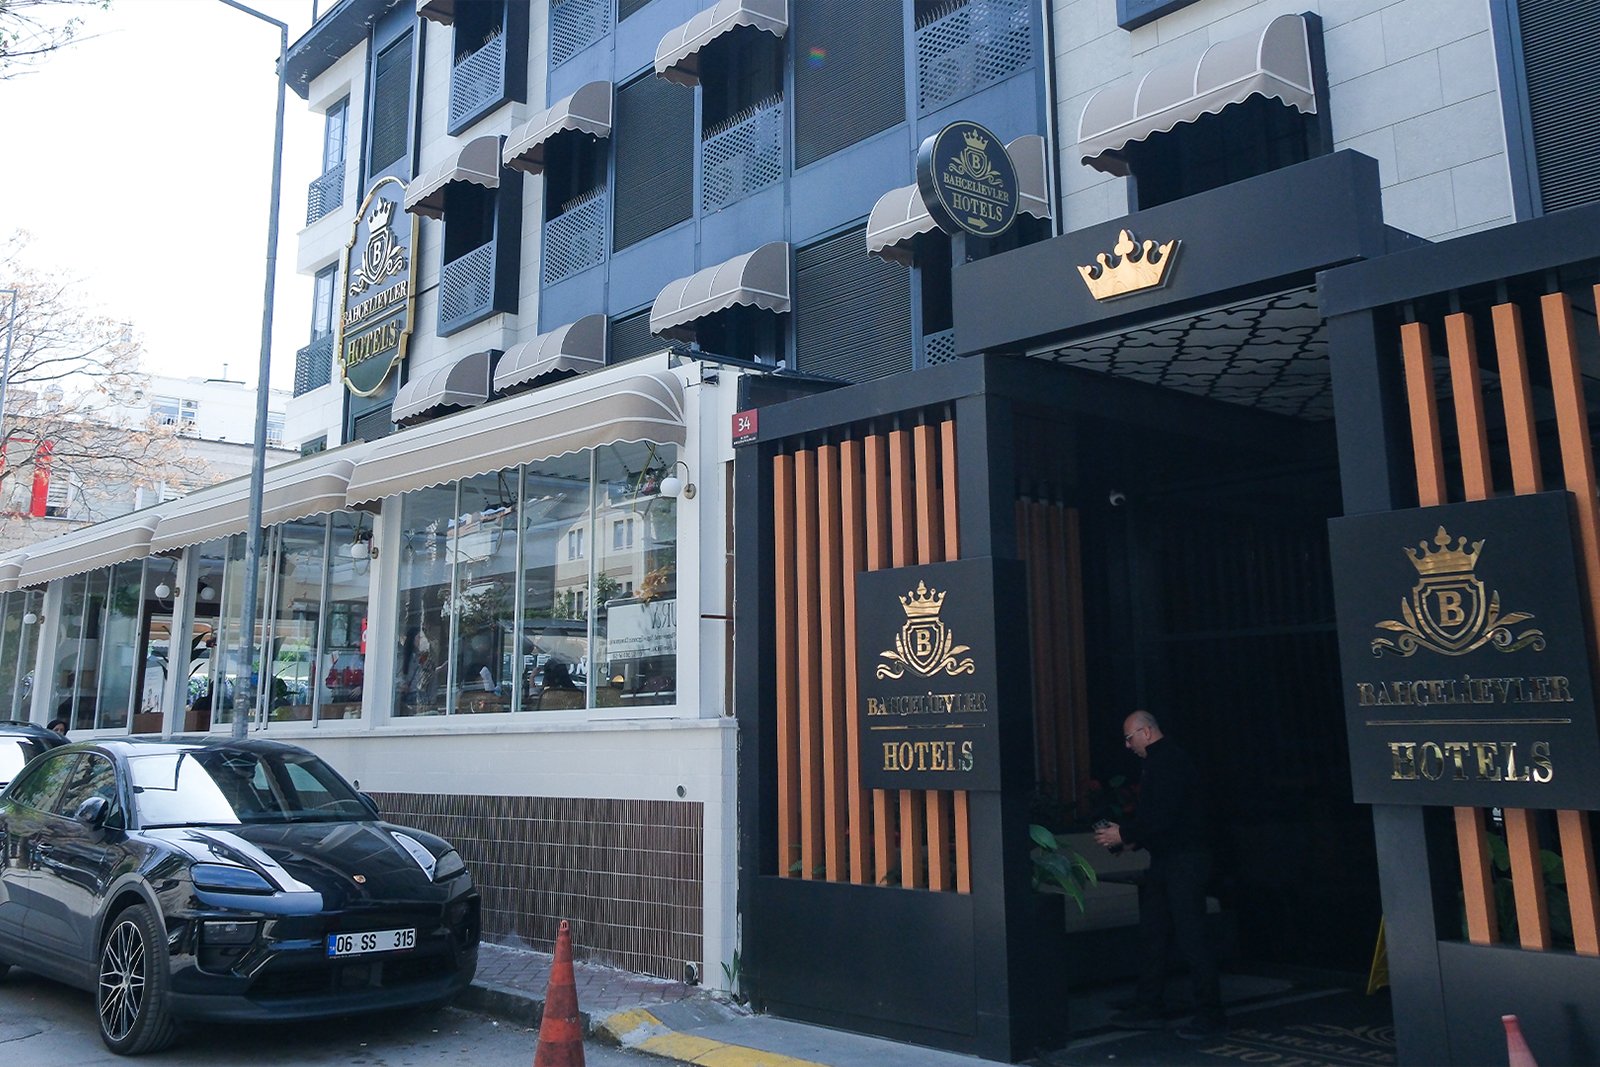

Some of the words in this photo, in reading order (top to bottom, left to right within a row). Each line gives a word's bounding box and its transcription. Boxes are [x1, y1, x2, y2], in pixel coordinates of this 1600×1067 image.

[952, 192, 1003, 222] HOTELS
[346, 320, 398, 366] HOTELS
[738, 416, 751, 432] 34
[1436, 591, 1465, 627] B
[916, 629, 931, 657] B
[882, 740, 974, 772] HOTELS
[1388, 741, 1555, 785] HOTELS
[337, 936, 352, 952] 06
[361, 934, 377, 950] SS
[393, 930, 414, 947] 315
